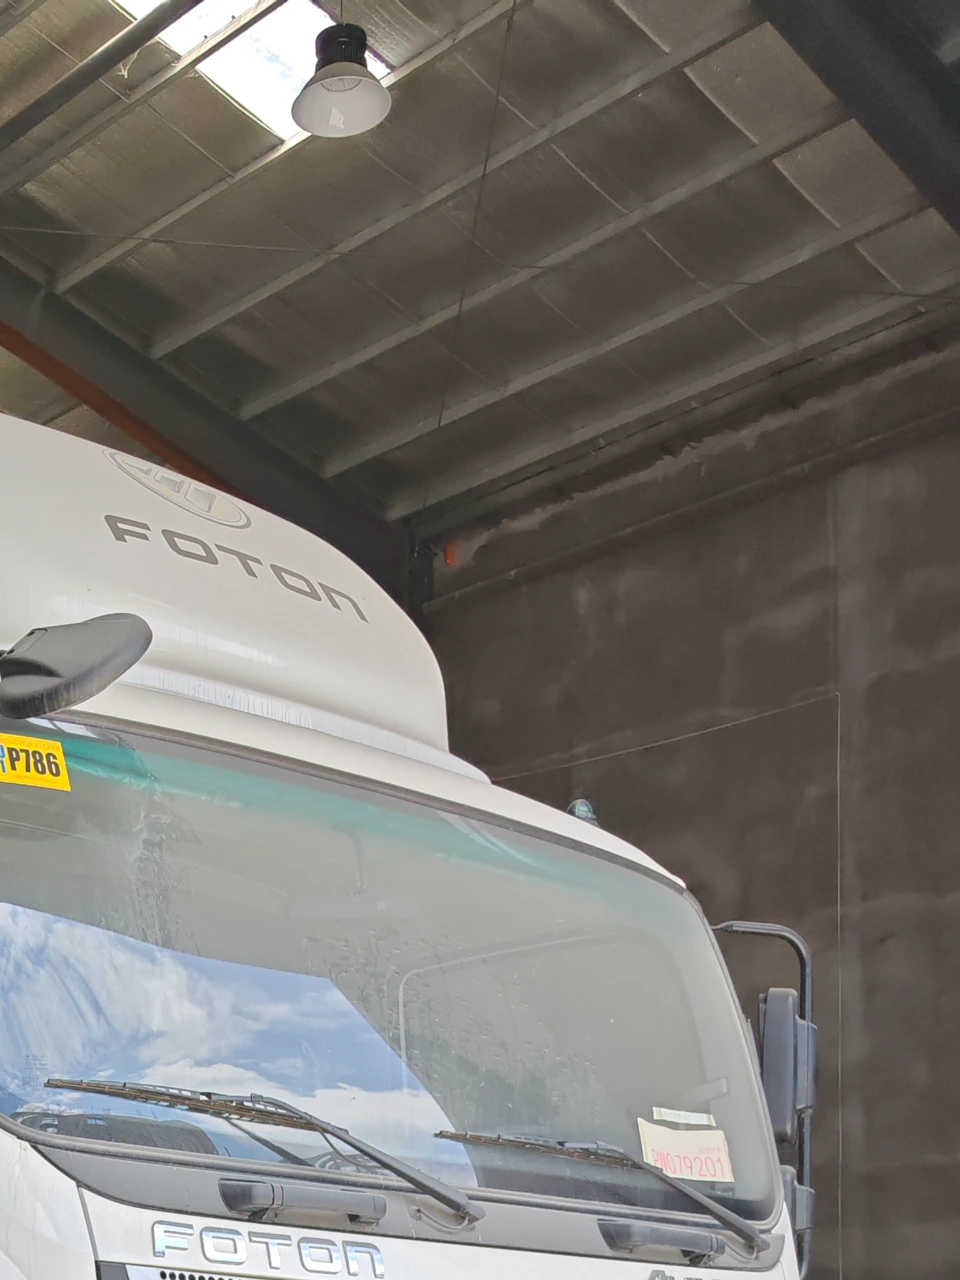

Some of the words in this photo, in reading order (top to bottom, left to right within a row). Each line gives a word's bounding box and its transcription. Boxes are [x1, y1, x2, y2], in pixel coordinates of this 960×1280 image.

[104, 514, 370, 624] FOTON
[7, 747, 61, 778] P786
[151, 1220, 385, 1279] FOTON
